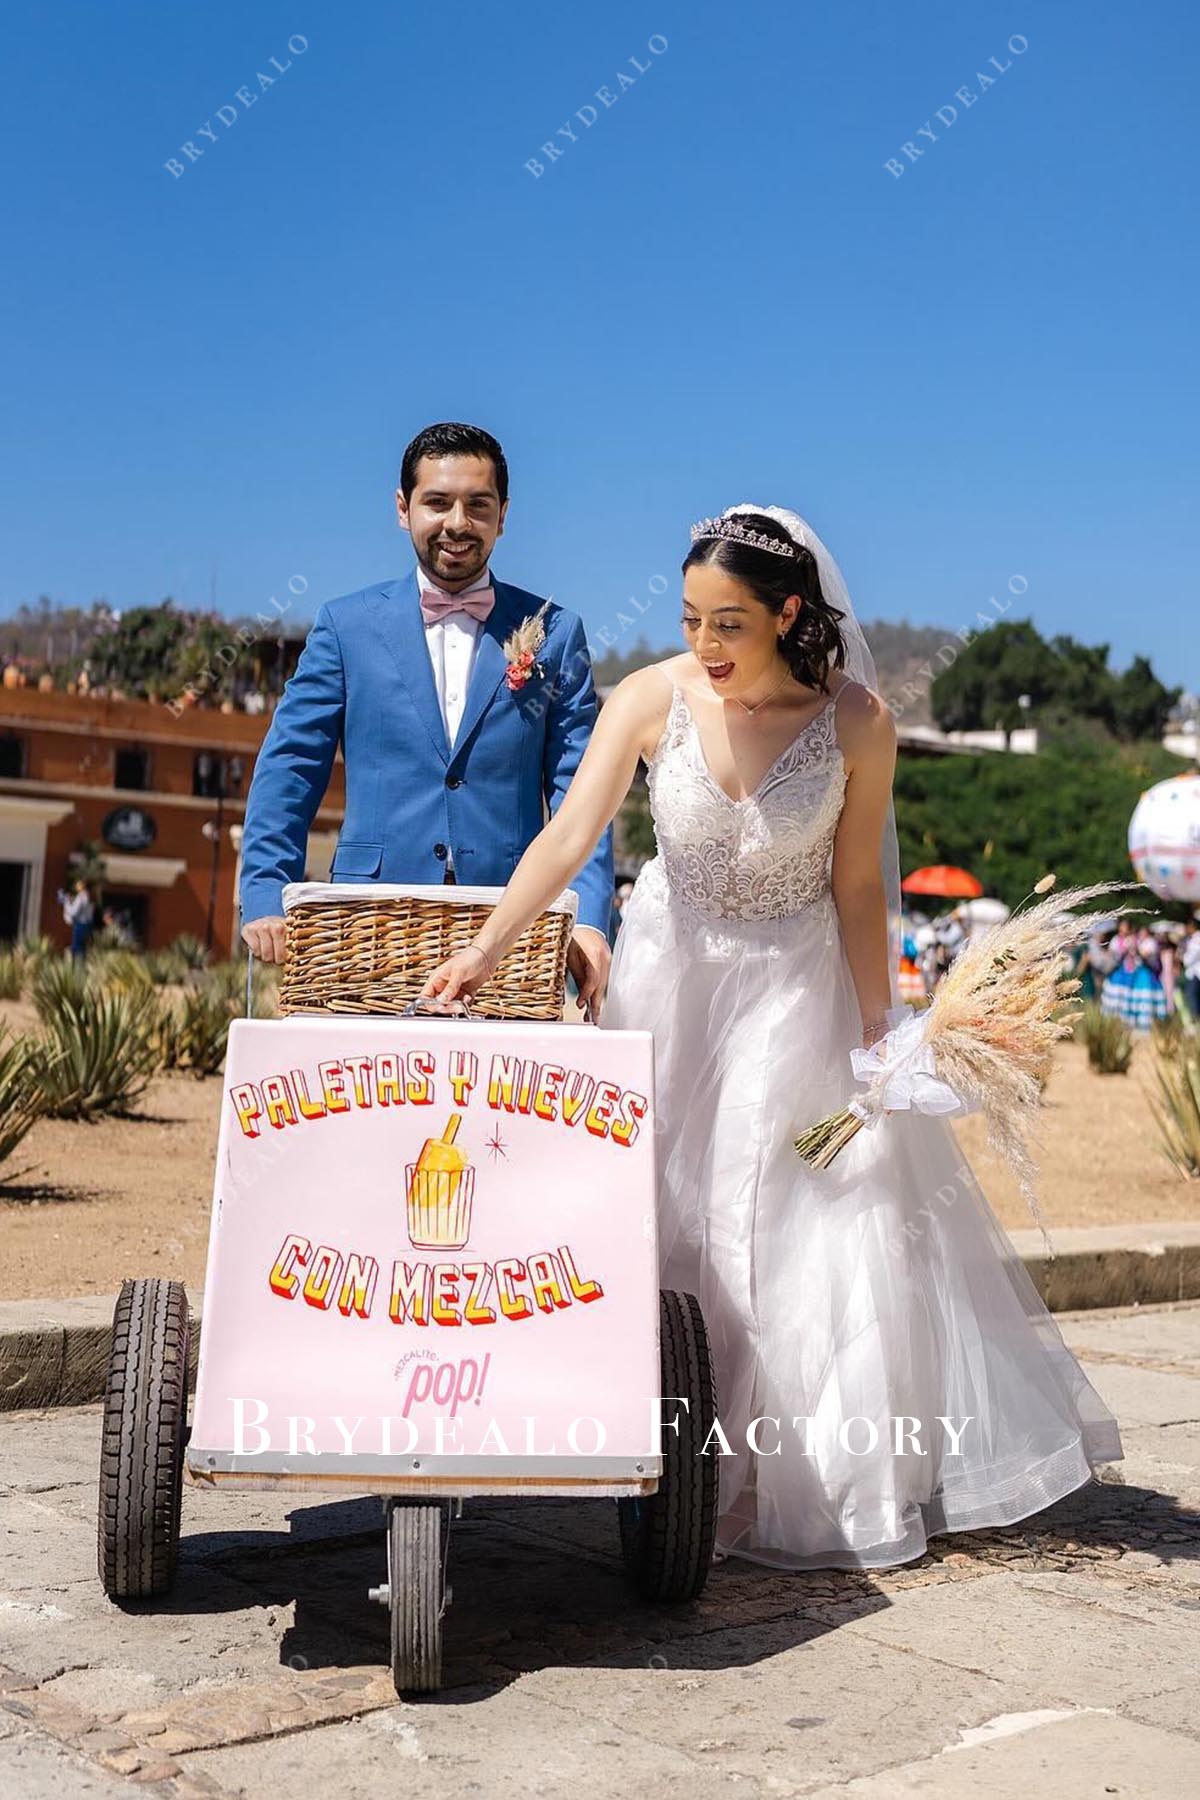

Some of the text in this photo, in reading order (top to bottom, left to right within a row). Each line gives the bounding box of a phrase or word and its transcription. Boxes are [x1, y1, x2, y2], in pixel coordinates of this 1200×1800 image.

[230, 1051, 649, 1148] PALETAS Y NIEVES
[269, 1234, 604, 1327] CON MEZCAL
[402, 1352, 491, 1420] pop!
